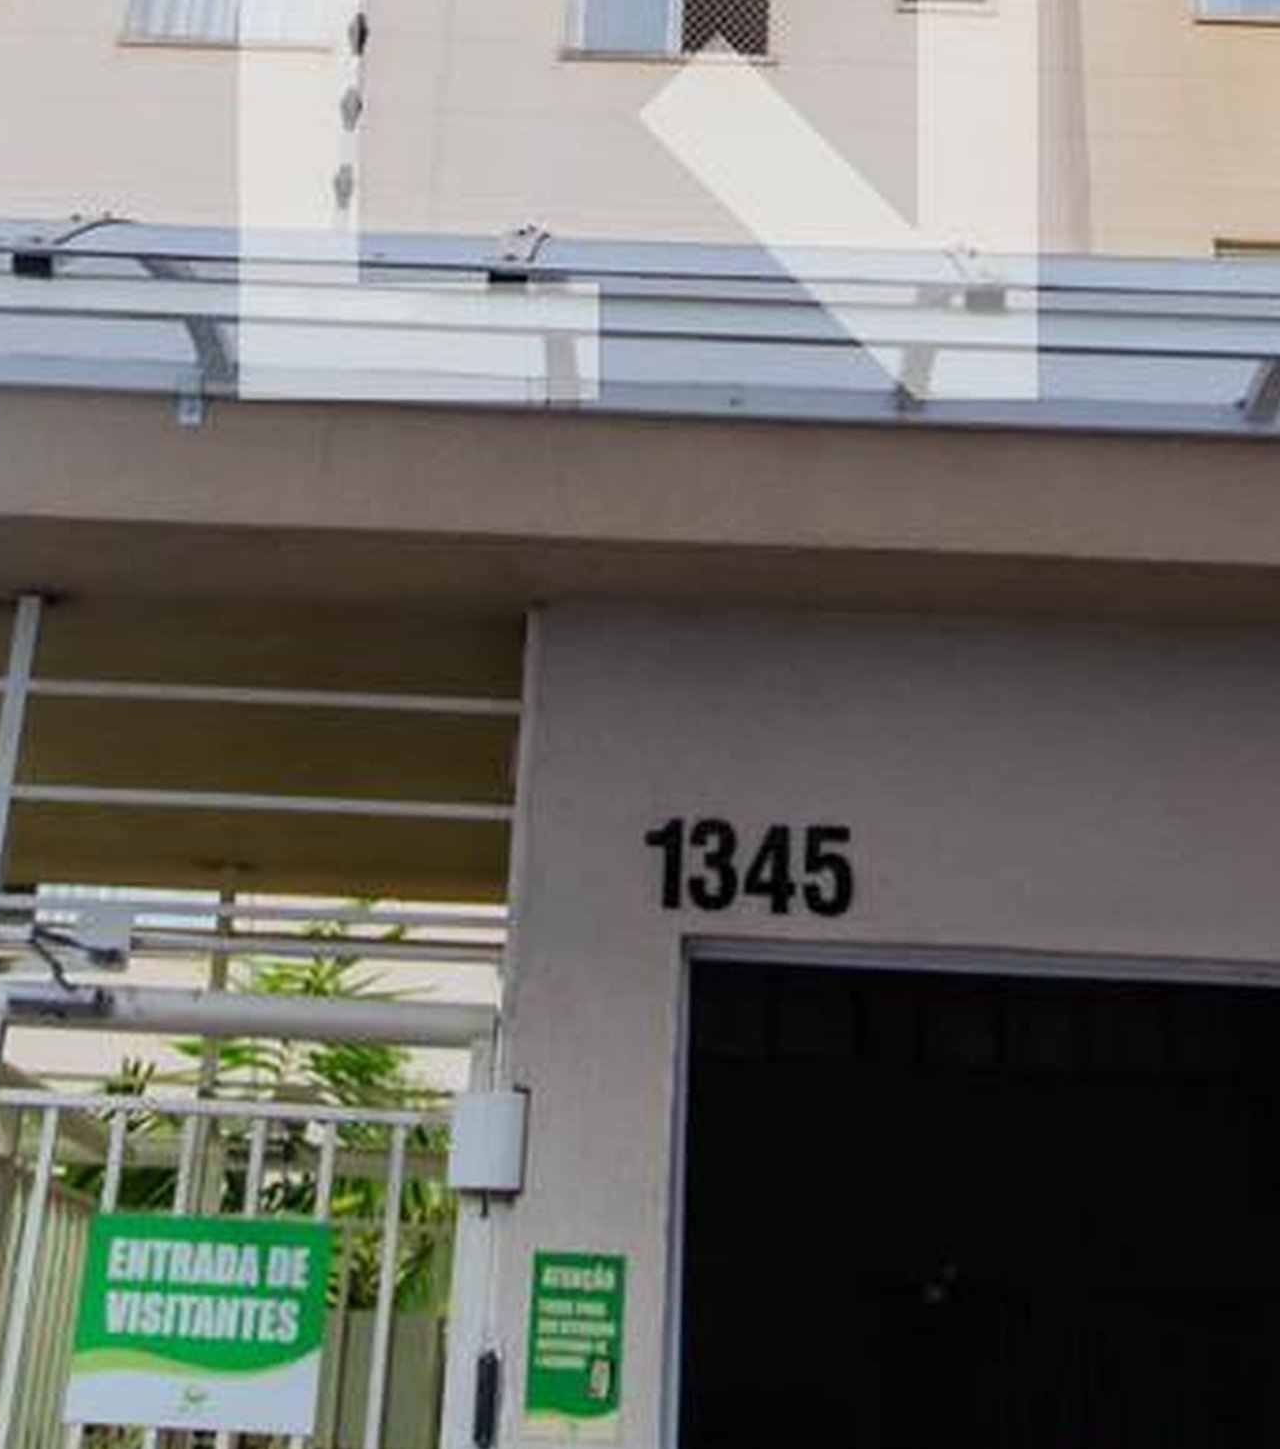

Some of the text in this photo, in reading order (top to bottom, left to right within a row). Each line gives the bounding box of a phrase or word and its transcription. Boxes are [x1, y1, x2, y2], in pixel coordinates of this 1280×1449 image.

[644, 818, 853, 917] 1345
[107, 1237, 310, 1290] ENTRADA DE
[105, 1289, 299, 1343] VISITANTES
